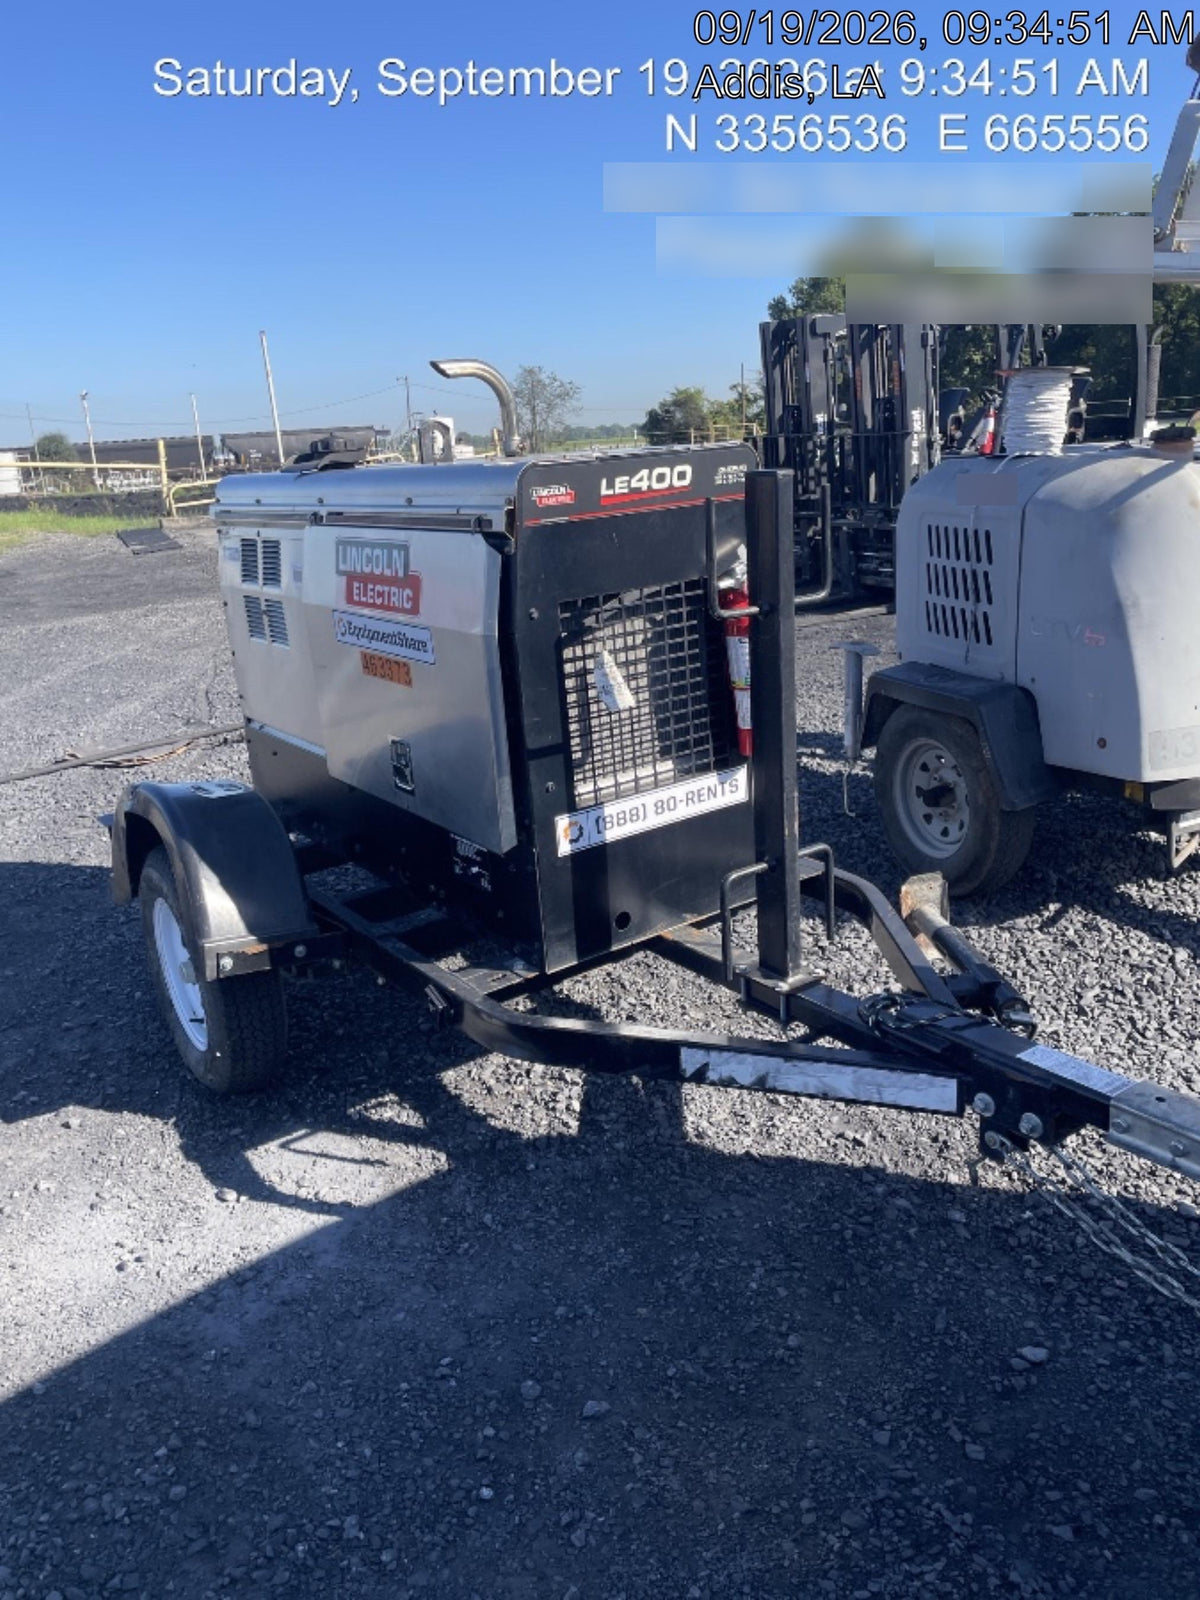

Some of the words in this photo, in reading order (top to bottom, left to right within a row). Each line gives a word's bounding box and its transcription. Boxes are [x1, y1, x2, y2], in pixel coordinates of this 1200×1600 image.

[600, 464, 693, 496] LE400
[338, 544, 405, 578] LINCOLN
[353, 581, 413, 609] ELECTRIC
[347, 621, 429, 653] EquipmentShare
[595, 803, 648, 835] (888)
[654, 777, 740, 816] 80-RENTS
